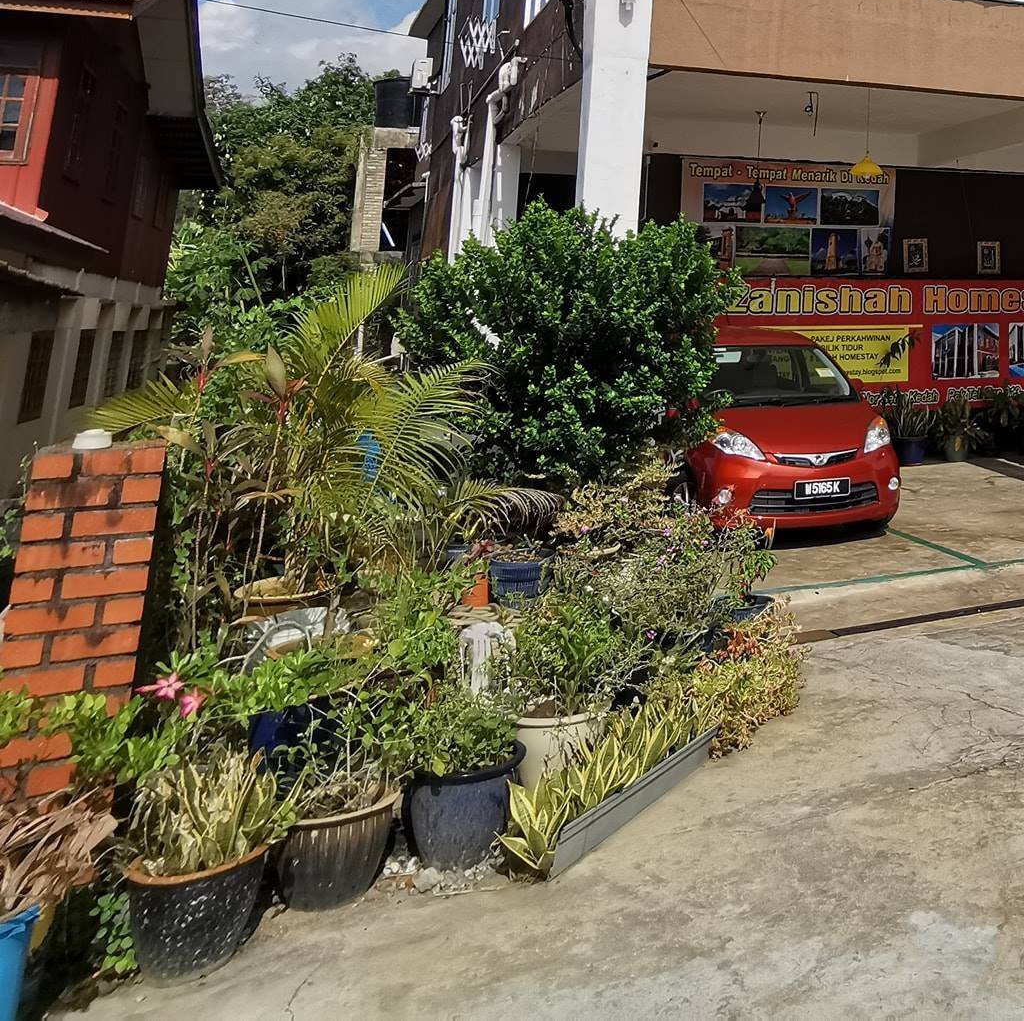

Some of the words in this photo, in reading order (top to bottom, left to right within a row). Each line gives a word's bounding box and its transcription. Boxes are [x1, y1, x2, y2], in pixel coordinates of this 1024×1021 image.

[690, 163, 733, 179] Tempat
[747, 165, 788, 181] Tempat
[792, 169, 837, 183] Menarik
[728, 284, 912, 315] Zanishah
